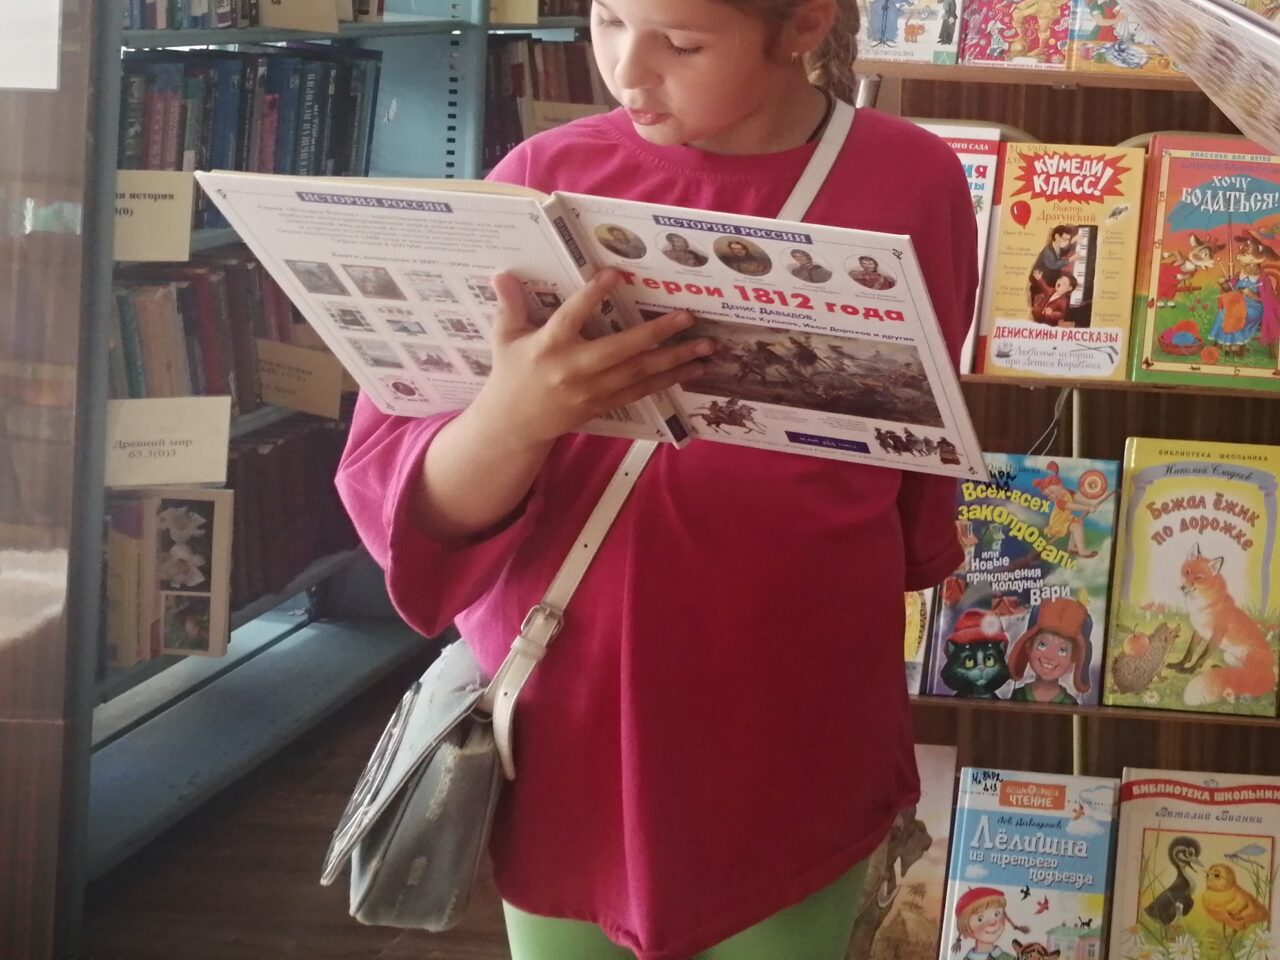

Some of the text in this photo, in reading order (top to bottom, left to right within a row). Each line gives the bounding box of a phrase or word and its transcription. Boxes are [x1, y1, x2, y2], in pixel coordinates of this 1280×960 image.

[969, 143, 989, 151] САДА
[1033, 166, 1114, 196] КЛАСС!
[1212, 176, 1251, 191] ХОЧУ
[129, 192, 174, 201] история
[302, 192, 448, 212] ИСТОРИЯ РОССИИ
[1182, 188, 1279, 214] БОДАТЬСЯ!
[659, 215, 806, 244] ИСТОРИЯ РОССИИ
[733, 284, 814, 310] 1812
[825, 301, 906, 323] года
[994, 326, 1119, 343] ДЕНИСКИНЫ РАССКАЗЫ
[113, 439, 165, 449] Древний
[1158, 450, 1268, 461] БИБЛИОТЕКА ШКОЛЬНИКА
[962, 482, 1050, 512] Всех-всех
[1146, 492, 1260, 528] Бежал ёжик
[958, 504, 1078, 569] заколдовали
[1150, 514, 1254, 552] по дорожке
[971, 556, 1009, 571] Новые
[981, 550, 999, 559] или
[966, 568, 1041, 585] приключения
[992, 579, 1043, 592] колдуньи
[1030, 585, 1071, 606] Вари
[1132, 783, 1210, 801] БИБЛИОТЕКА
[1009, 795, 1053, 808] ЧТЕНИЕ
[1155, 806, 1263, 824] Виталий Бианки
[970, 815, 1088, 858] Лёлишна
[969, 850, 1058, 868] из третьего
[1029, 868, 1094, 889] подъезда
